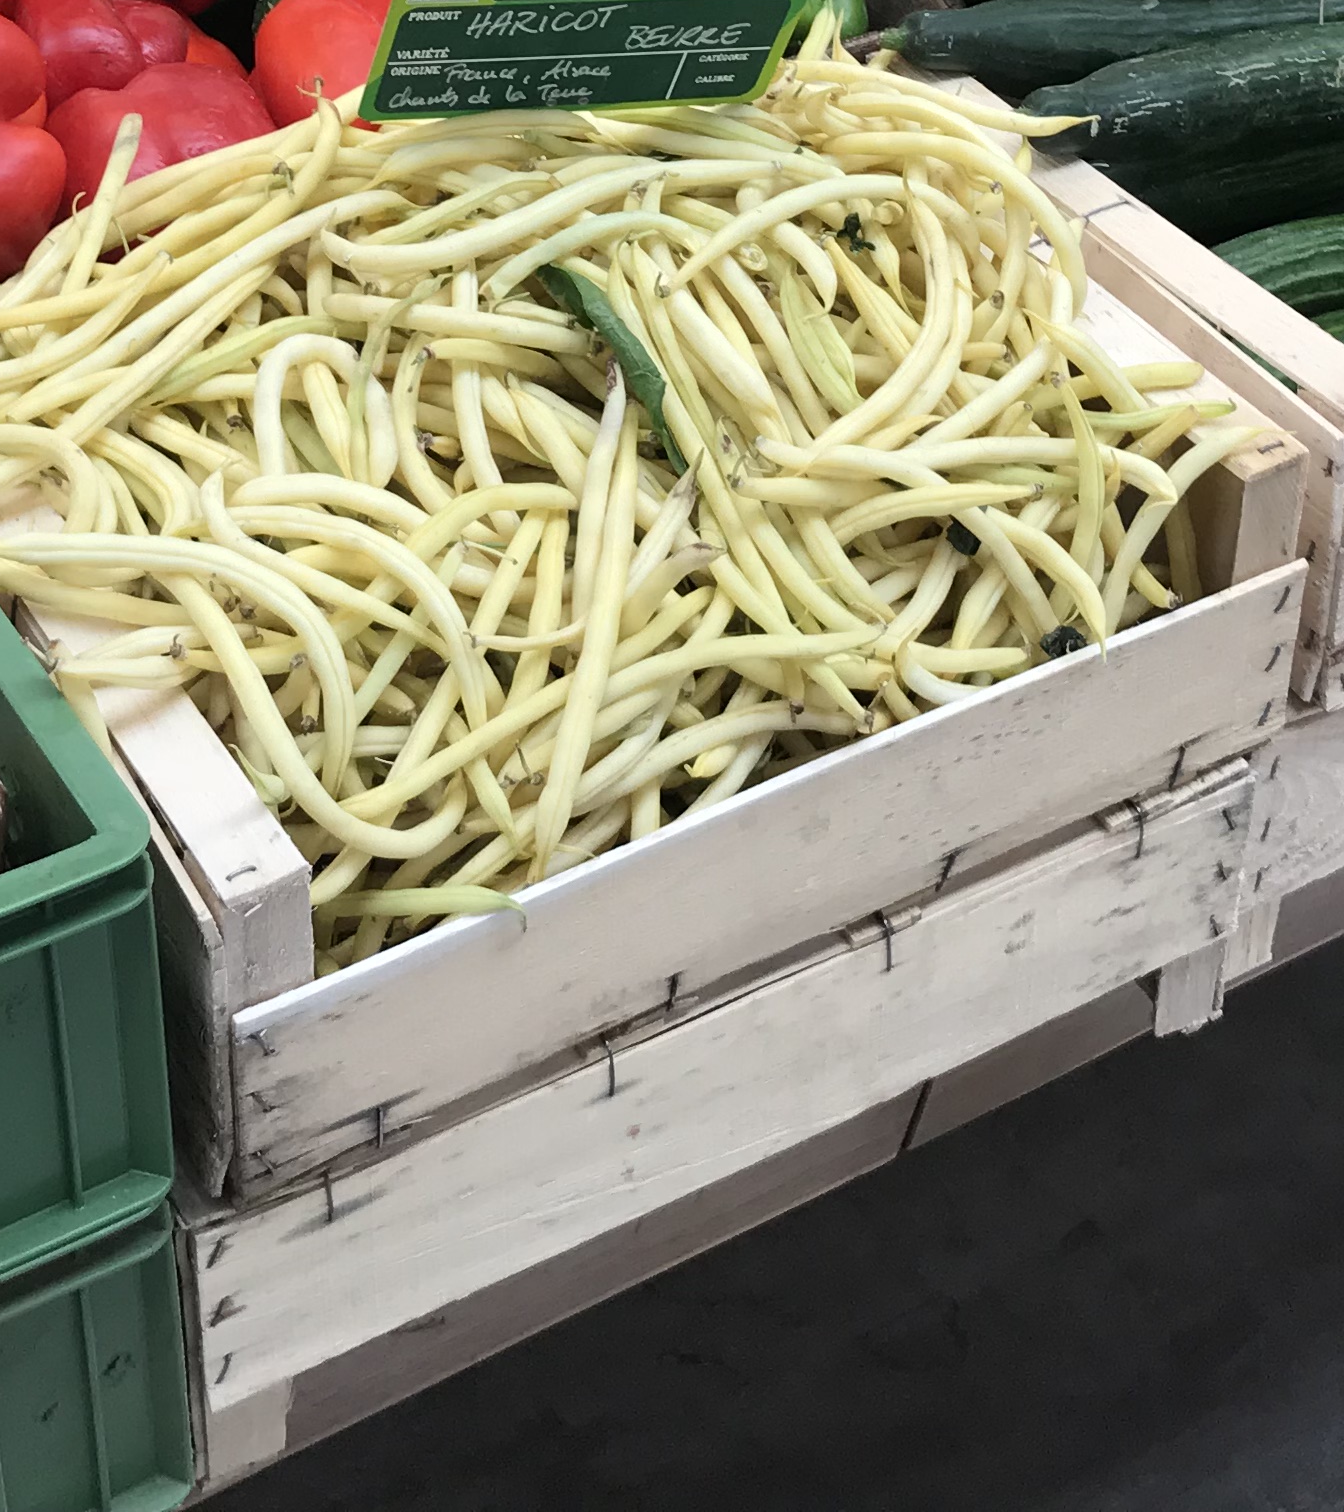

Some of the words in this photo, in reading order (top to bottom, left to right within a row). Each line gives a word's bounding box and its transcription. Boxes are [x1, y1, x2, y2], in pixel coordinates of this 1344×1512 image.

[408, 9, 462, 23] PRODUIT
[465, 3, 629, 40] HARICOT
[625, 23, 752, 51] BEURRE
[396, 47, 451, 60] VARIÉTÉ
[390, 65, 441, 77] ORIGINE
[541, 60, 613, 83] Alsace
[468, 84, 492, 104] de
[505, 84, 527, 102] la
